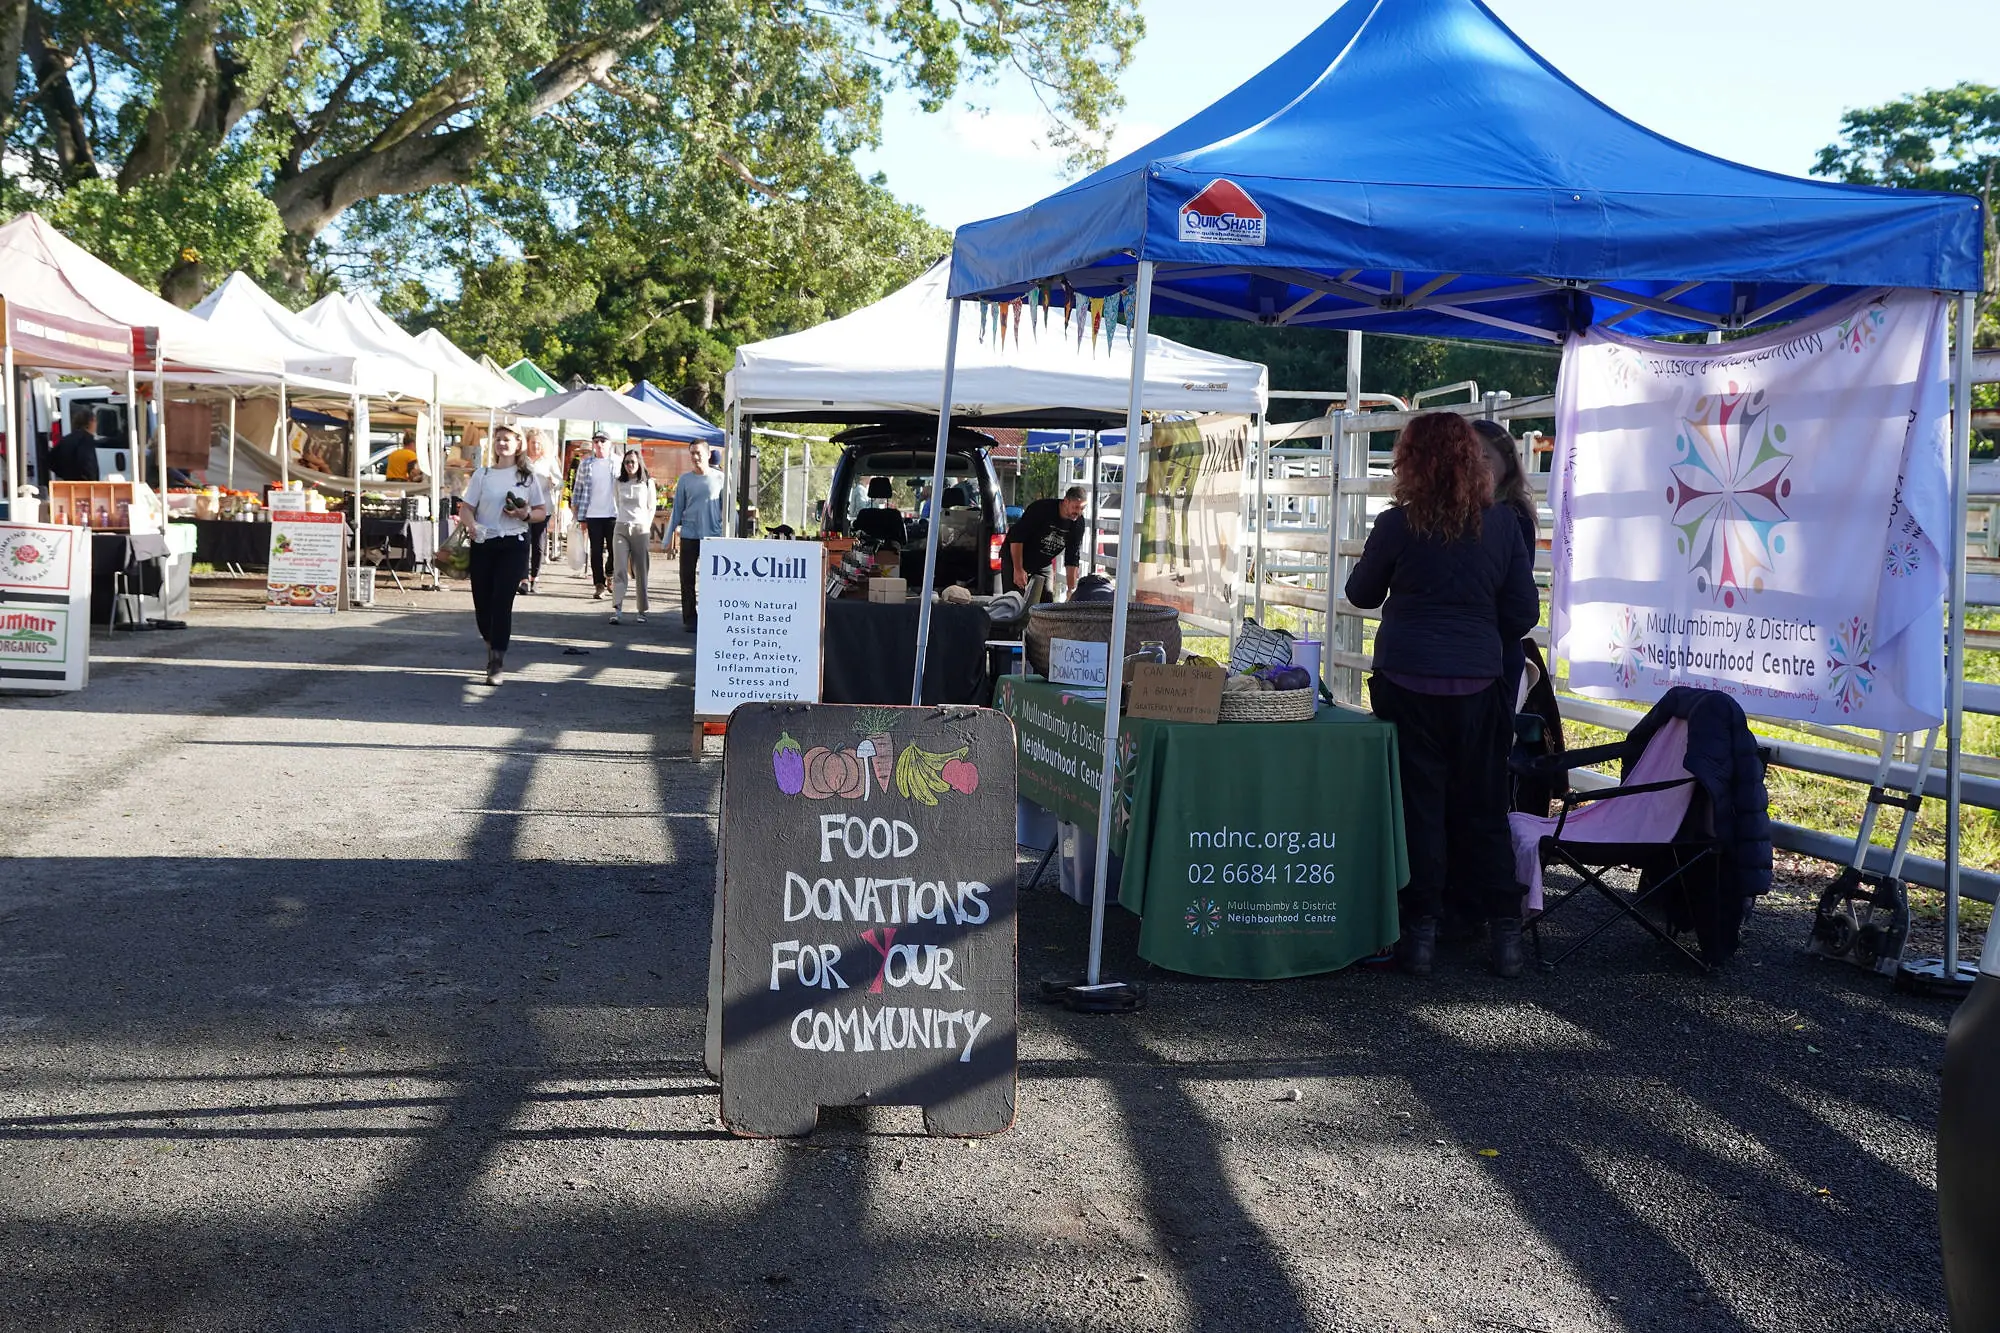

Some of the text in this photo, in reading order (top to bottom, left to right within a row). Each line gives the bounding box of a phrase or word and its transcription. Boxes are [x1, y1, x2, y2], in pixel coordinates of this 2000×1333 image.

[1186, 211, 1261, 231] QUIKSHADE
[1650, 360, 1695, 377] District
[31, 532, 47, 543] RED
[718, 599, 798, 610] 100% Natural
[0, 613, 56, 632] UMMIT
[723, 612, 792, 623] Plant Based
[726, 625, 788, 636] Assistance
[1646, 612, 1816, 642] Mullumbimby & District
[732, 637, 782, 649] for Pain,
[714, 650, 801, 663] Sleep, Anxiety,
[1064, 646, 1089, 664] CASH
[1647, 643, 1815, 676] Neighbourhood Centre
[717, 663, 798, 675] Inflammation,
[1052, 663, 1106, 683] DONATIONS
[1143, 667, 1213, 680] CAN YOU SPARE
[728, 676, 790, 687] Stress and
[711, 689, 799, 700] Neurodiversity
[1142, 688, 1148, 696] A
[1694, 677, 1707, 689] the
[1712, 677, 1737, 694] Byron
[1741, 679, 1763, 697] Shire
[1767, 685, 1821, 714] Community
[1021, 699, 1105, 756] Mullumbimby & Distric
[1021, 730, 1076, 778] Neighbourhood
[1080, 760, 1104, 792] Centr
[819, 813, 919, 863] FOOD
[1189, 826, 1336, 855] mdnc.org.au
[1188, 863, 1335, 884] 02 6684 1286
[784, 870, 991, 925] DONATIONS
[1227, 900, 1336, 912] Mullumbimby & District
[1227, 913, 1337, 925] Neighbourhood Centre
[769, 927, 965, 994] FOR YOUR
[790, 1005, 992, 1063] COMMUNITY
